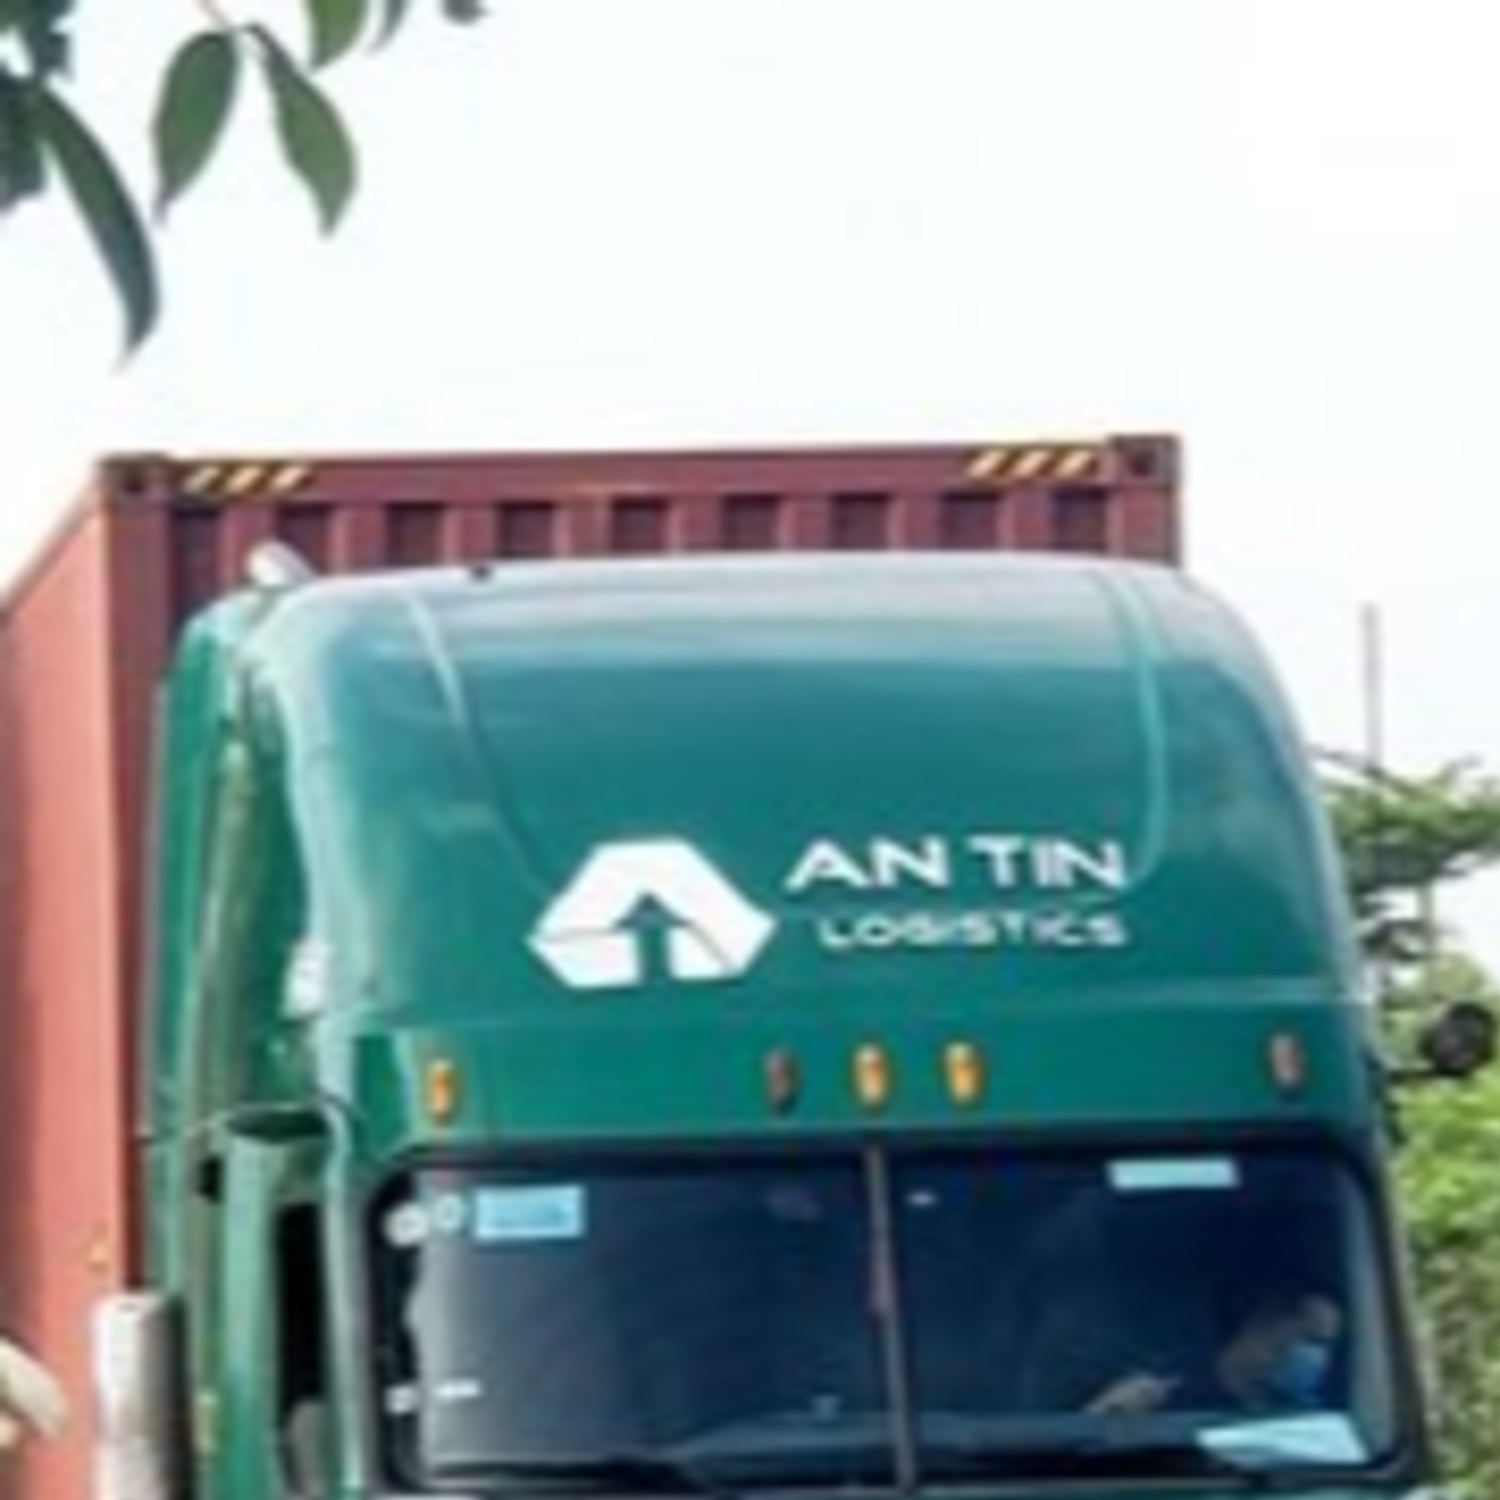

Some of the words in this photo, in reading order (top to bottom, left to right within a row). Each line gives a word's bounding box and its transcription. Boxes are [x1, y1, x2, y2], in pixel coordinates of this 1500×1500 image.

[786, 836, 949, 890] AN
[966, 834, 1125, 889] TIN
[818, 911, 1128, 947] LOGISTICS
